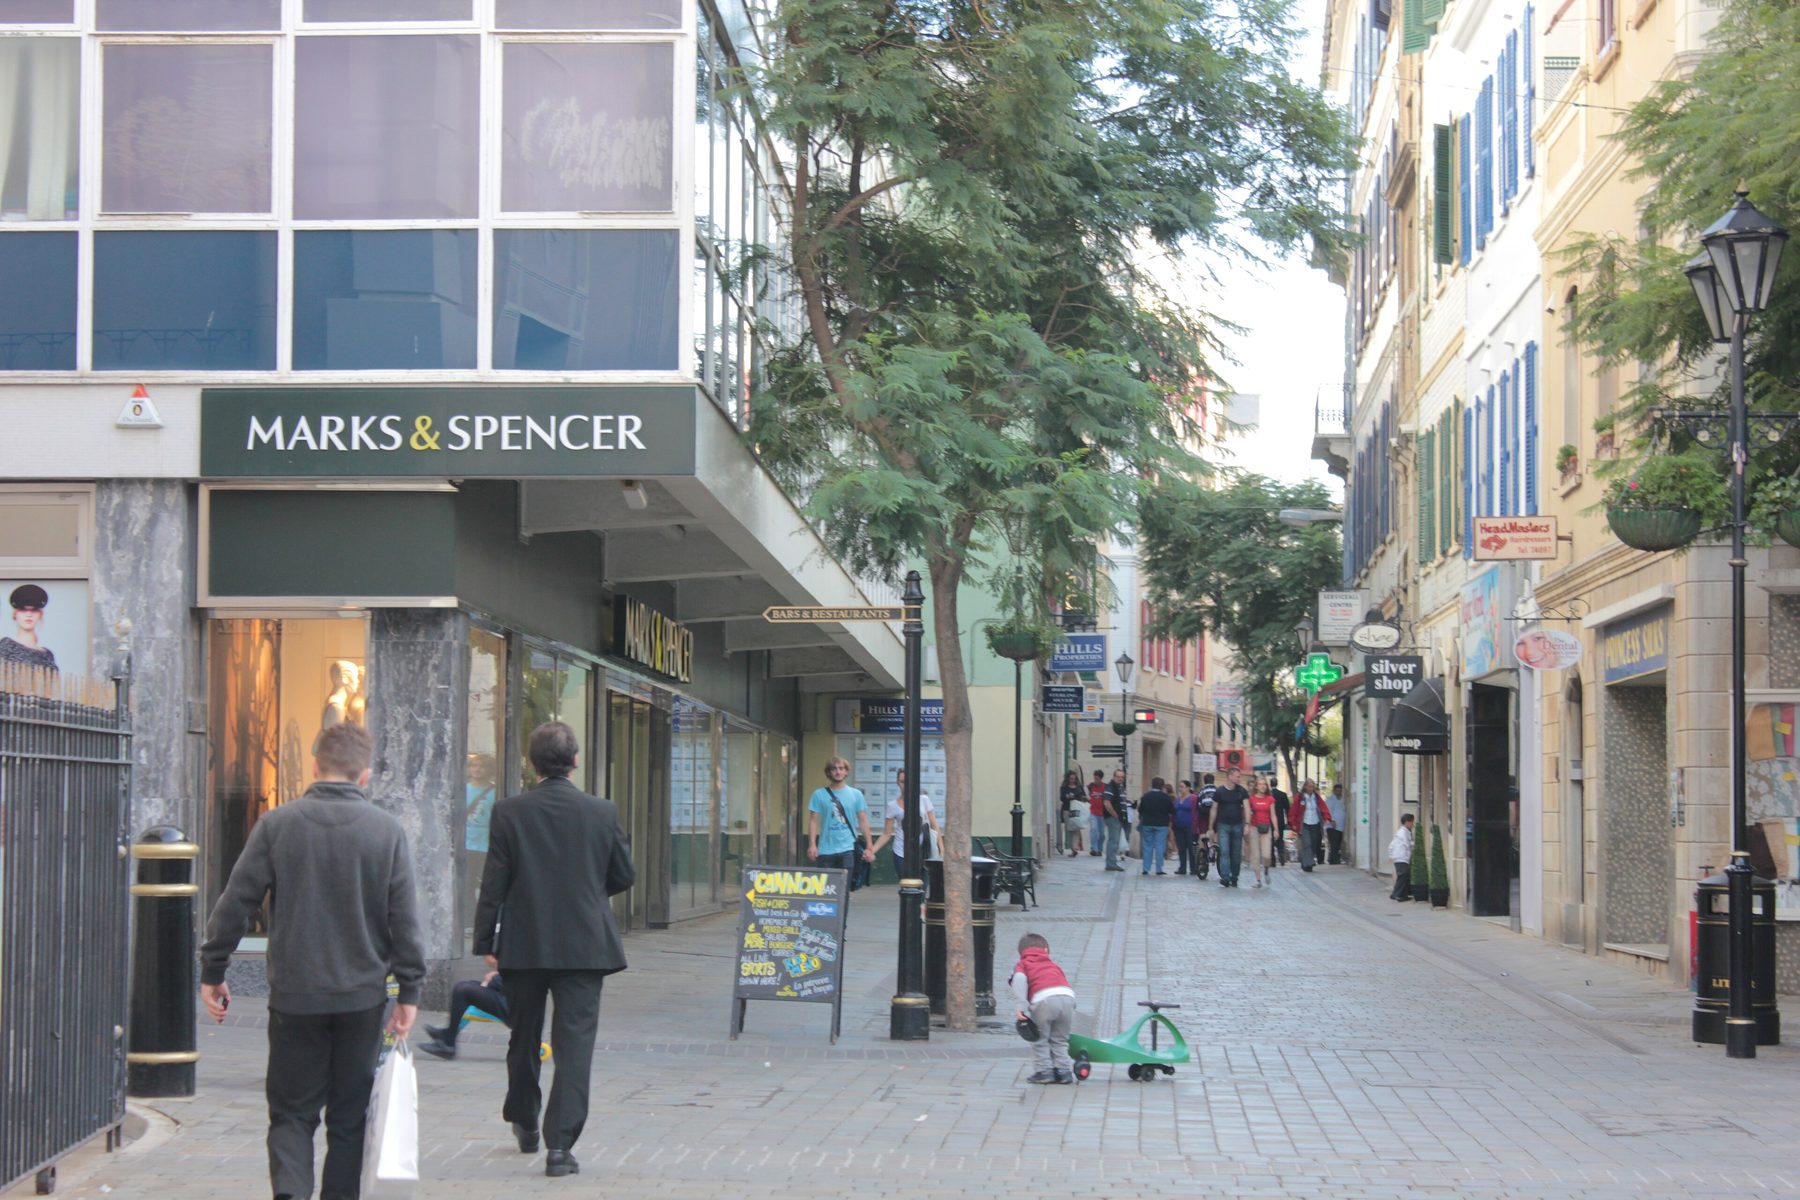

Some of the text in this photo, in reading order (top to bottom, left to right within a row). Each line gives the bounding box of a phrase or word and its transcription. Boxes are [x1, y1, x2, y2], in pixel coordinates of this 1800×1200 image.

[246, 415, 647, 451] MARKS & SPENCER
[772, 609, 890, 619] BARS & RESTAURANTS
[624, 594, 694, 683] MARKS & SPENCER
[1543, 640, 1578, 650] Dental
[1606, 618, 1665, 671] PRINCESS SILKS
[1055, 644, 1103, 654] HILLS
[1371, 659, 1417, 674] silver
[1374, 675, 1413, 694] shop
[868, 705, 898, 714] HILLS
[754, 871, 828, 896] CANNON
[741, 962, 776, 976] SPORTS
